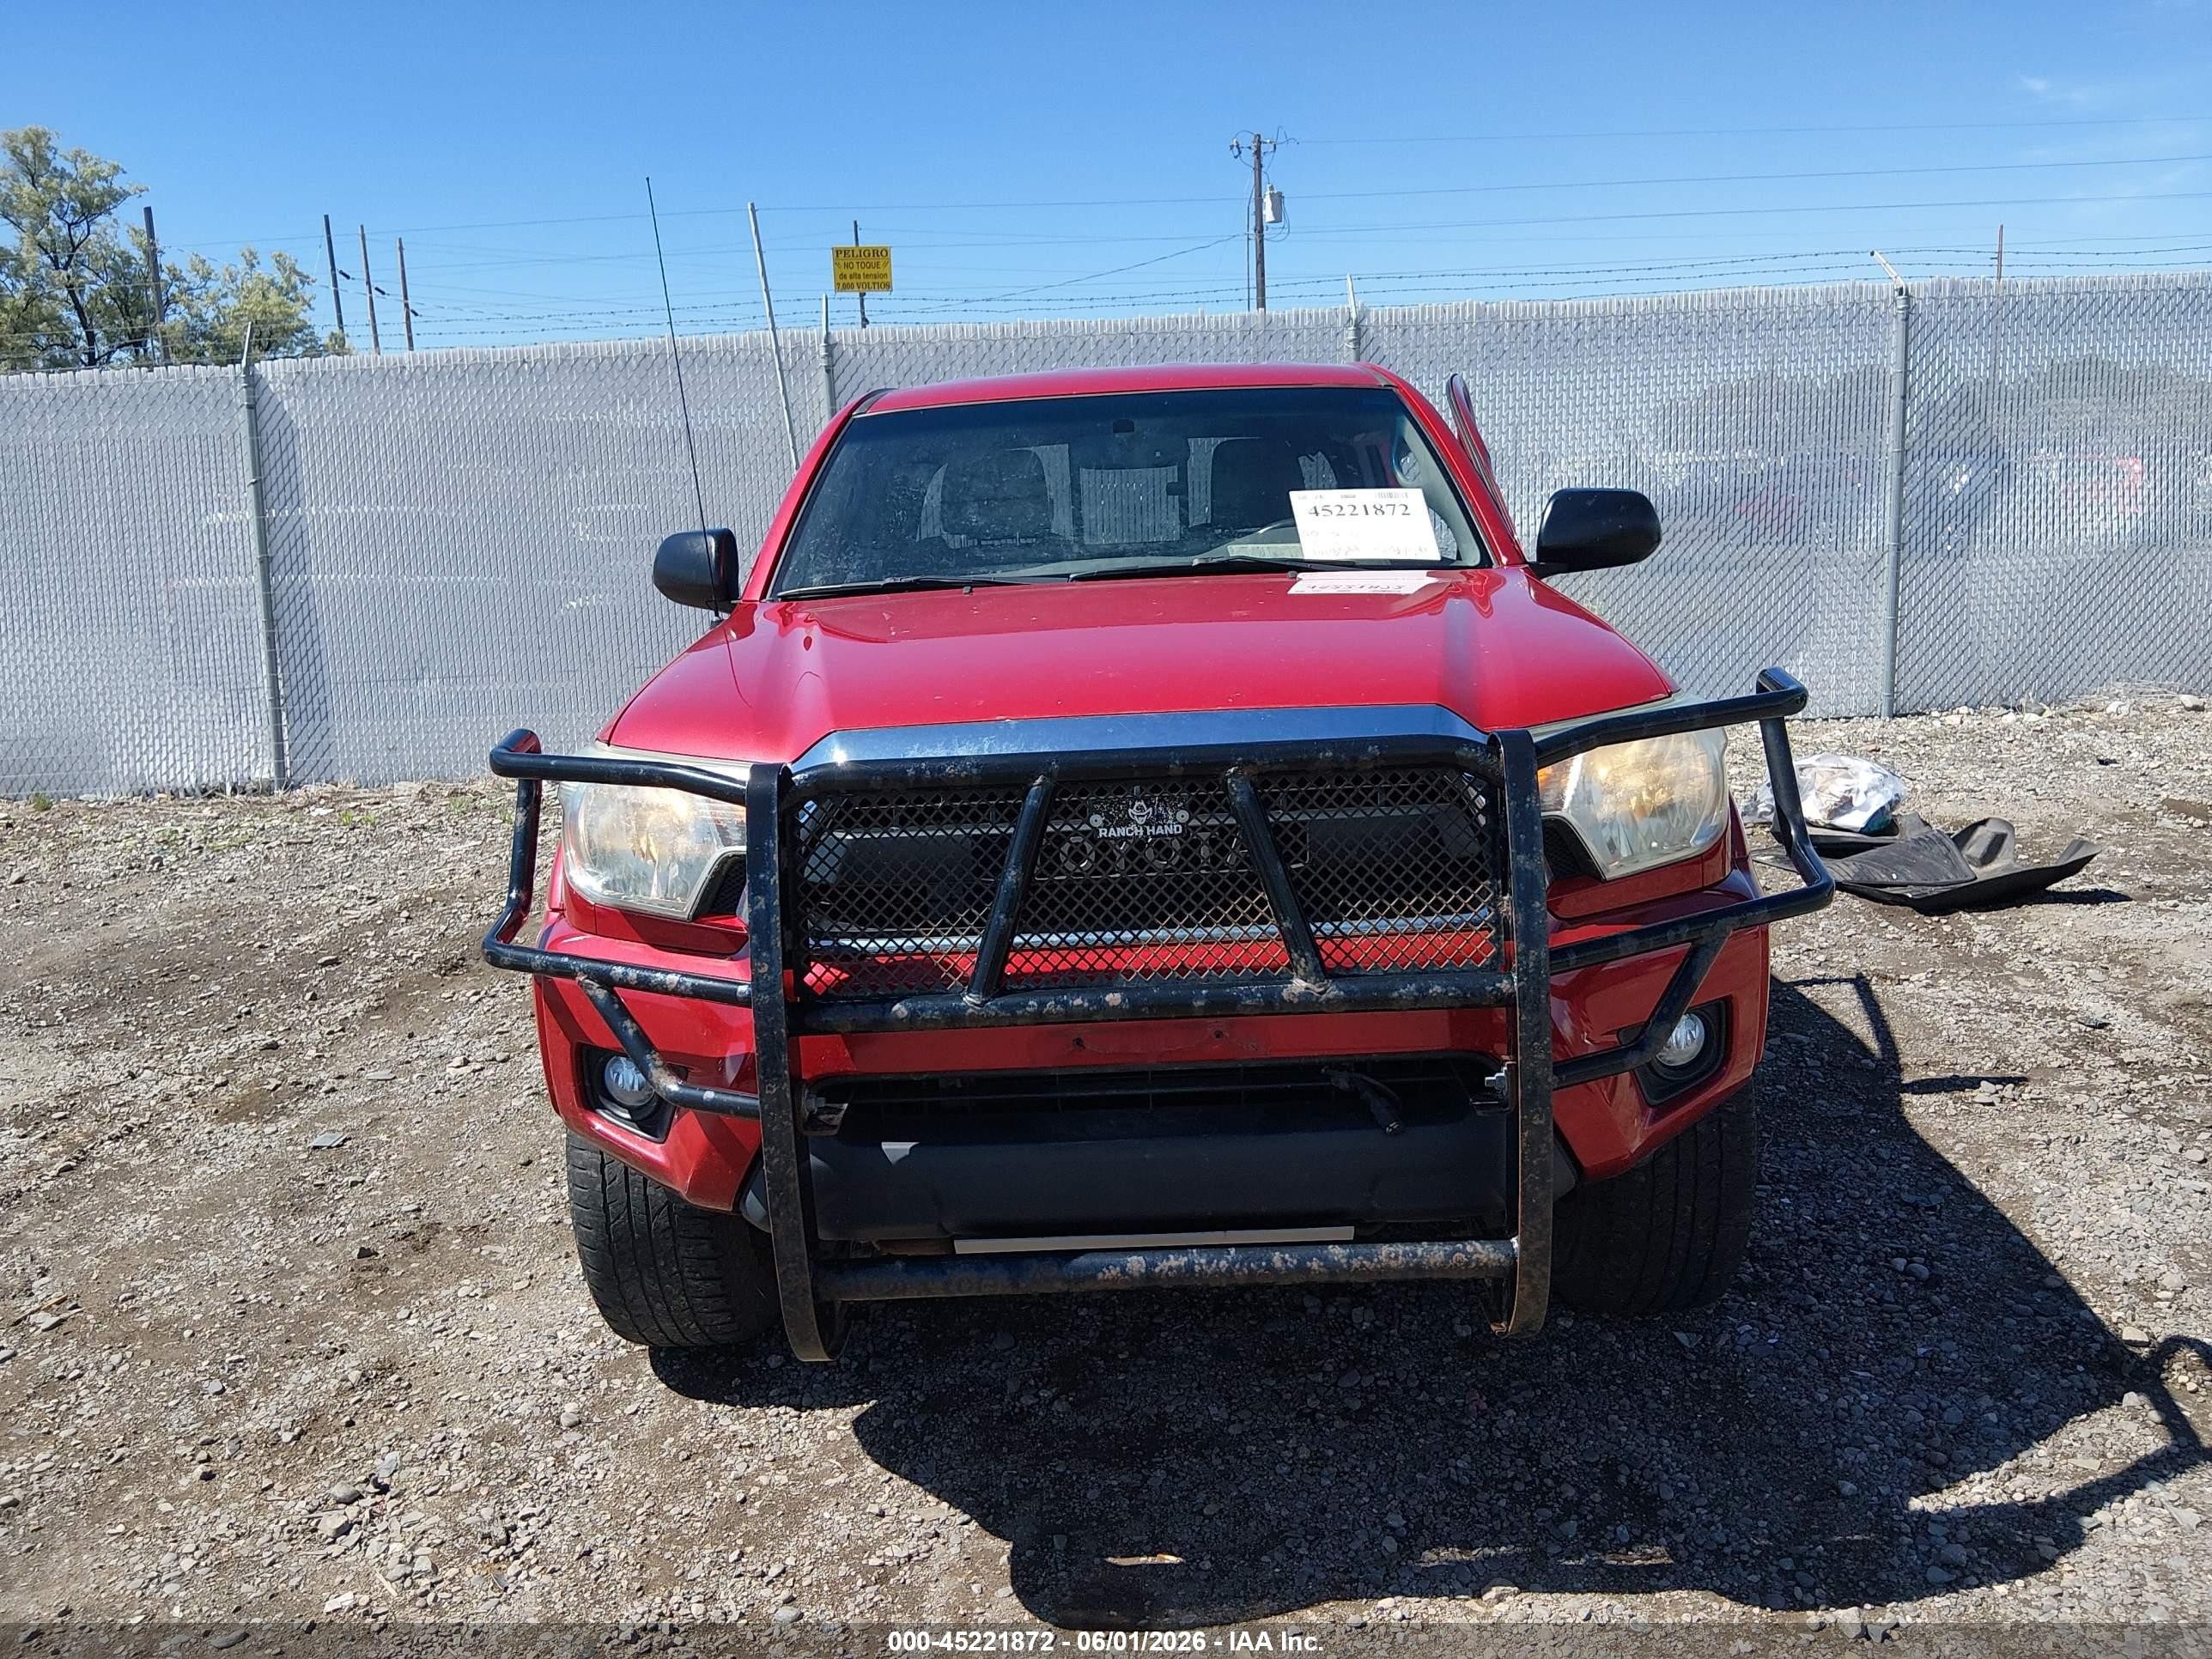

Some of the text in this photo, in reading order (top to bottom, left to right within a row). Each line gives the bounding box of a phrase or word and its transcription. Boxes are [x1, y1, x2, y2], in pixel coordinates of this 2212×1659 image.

[836, 249, 888, 258] PELIGRO
[844, 261, 880, 270] NO TOQUE
[849, 271, 861, 280] alta
[863, 271, 888, 280] tension
[1308, 504, 1411, 517] 45221872
[1098, 823, 1183, 838] RANCH HAND
